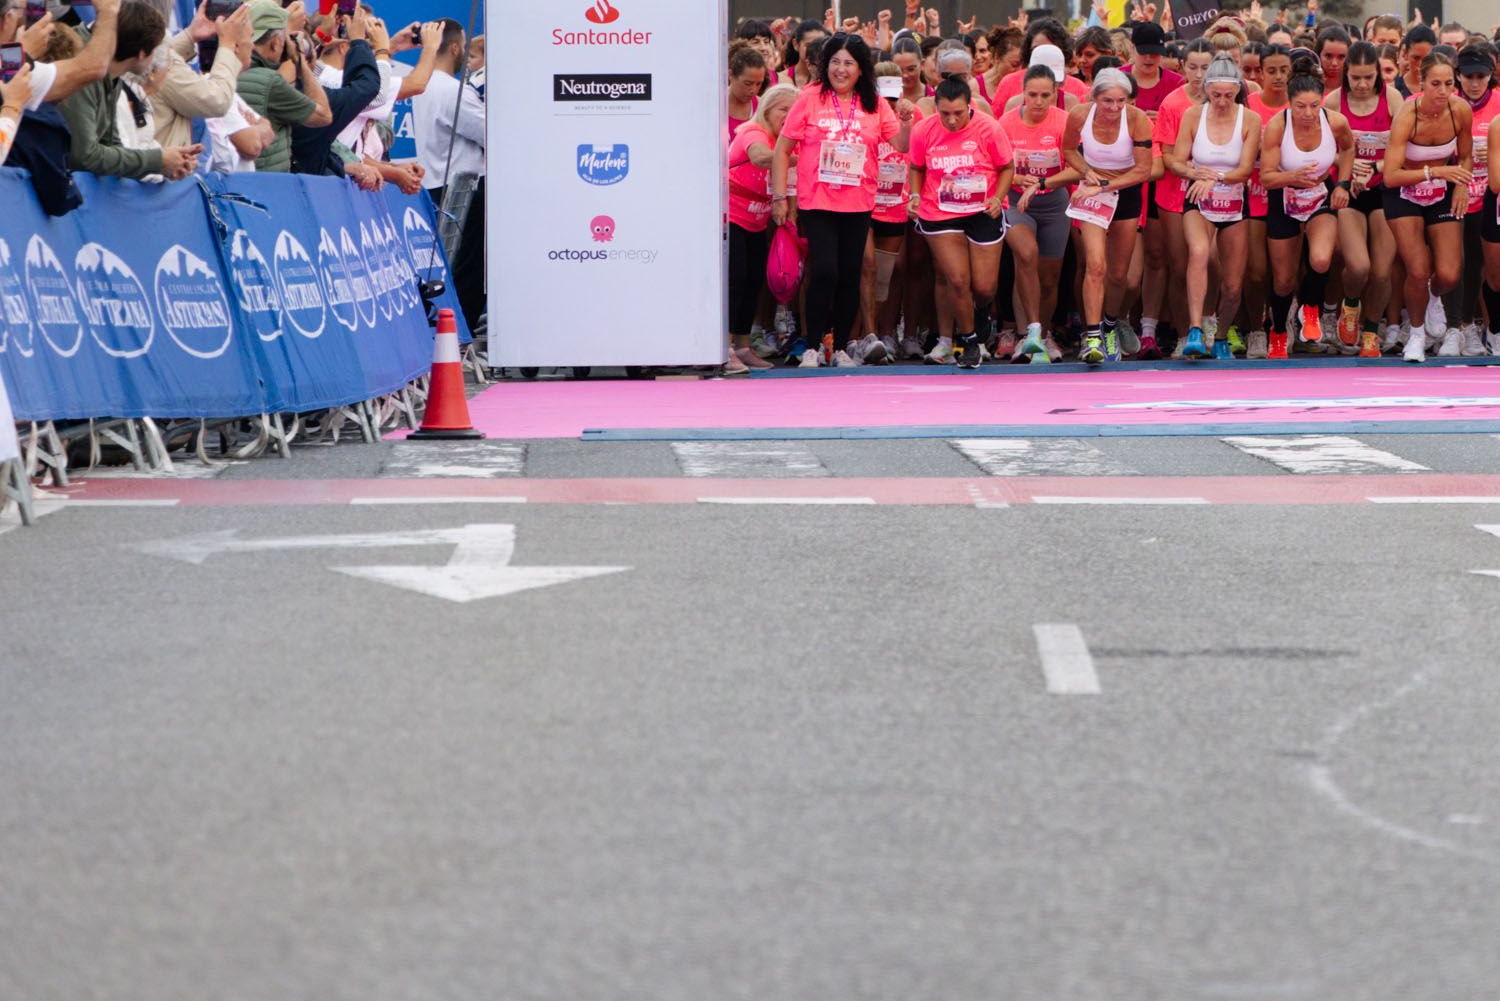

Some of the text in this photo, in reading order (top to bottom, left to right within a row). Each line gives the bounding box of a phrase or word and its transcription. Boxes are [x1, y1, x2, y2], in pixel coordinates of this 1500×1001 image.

[552, 28, 653, 46] Santander
[559, 79, 647, 99] Neutrogena
[1358, 147, 1376, 156] 016
[579, 152, 627, 175] Marlene
[834, 160, 851, 169] 016
[931, 155, 975, 171] CARRERA
[1028, 166, 1048, 177] 016
[953, 192, 972, 200] 016
[1212, 199, 1230, 208] 016
